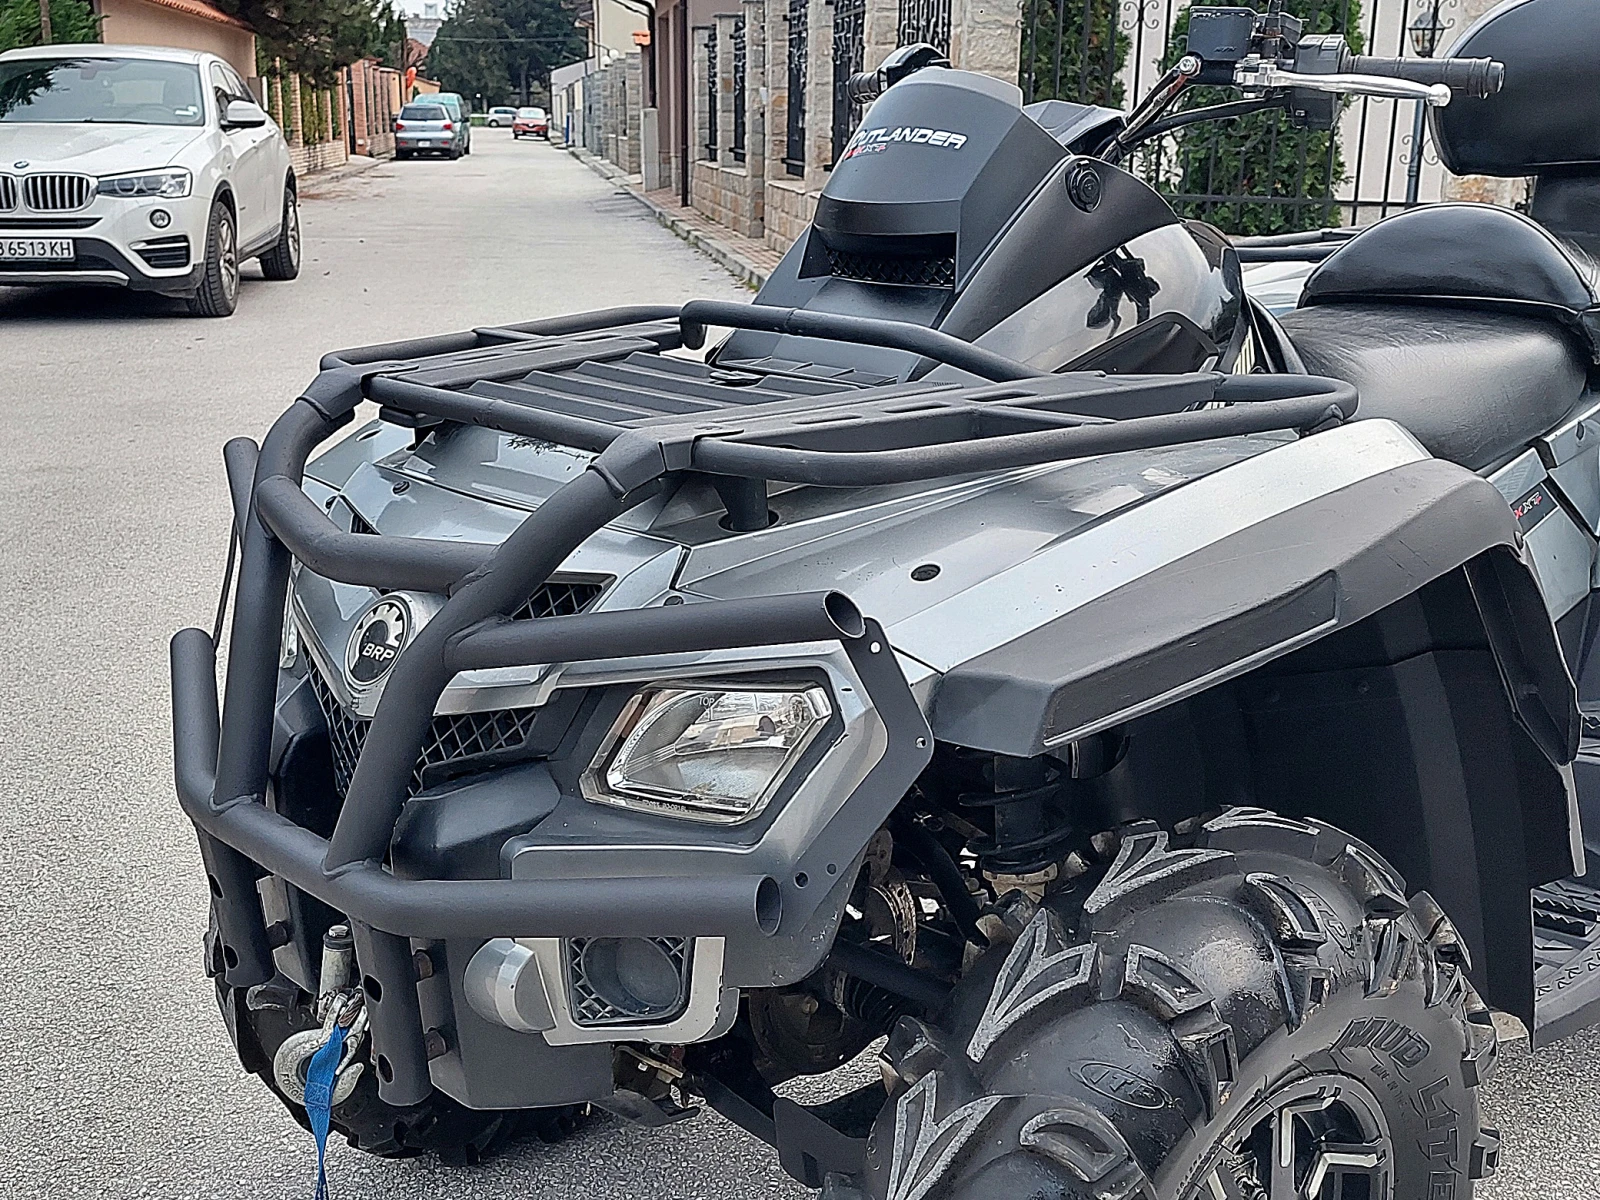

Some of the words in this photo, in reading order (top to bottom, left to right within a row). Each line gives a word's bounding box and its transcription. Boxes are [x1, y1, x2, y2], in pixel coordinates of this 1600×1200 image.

[849, 127, 968, 150] OUTLANDER
[8, 241, 47, 256] 6513
[49, 241, 71, 256] KH
[361, 642, 396, 662] BRP
[699, 696, 715, 707] TOP
[1328, 1016, 1432, 1069] MUD
